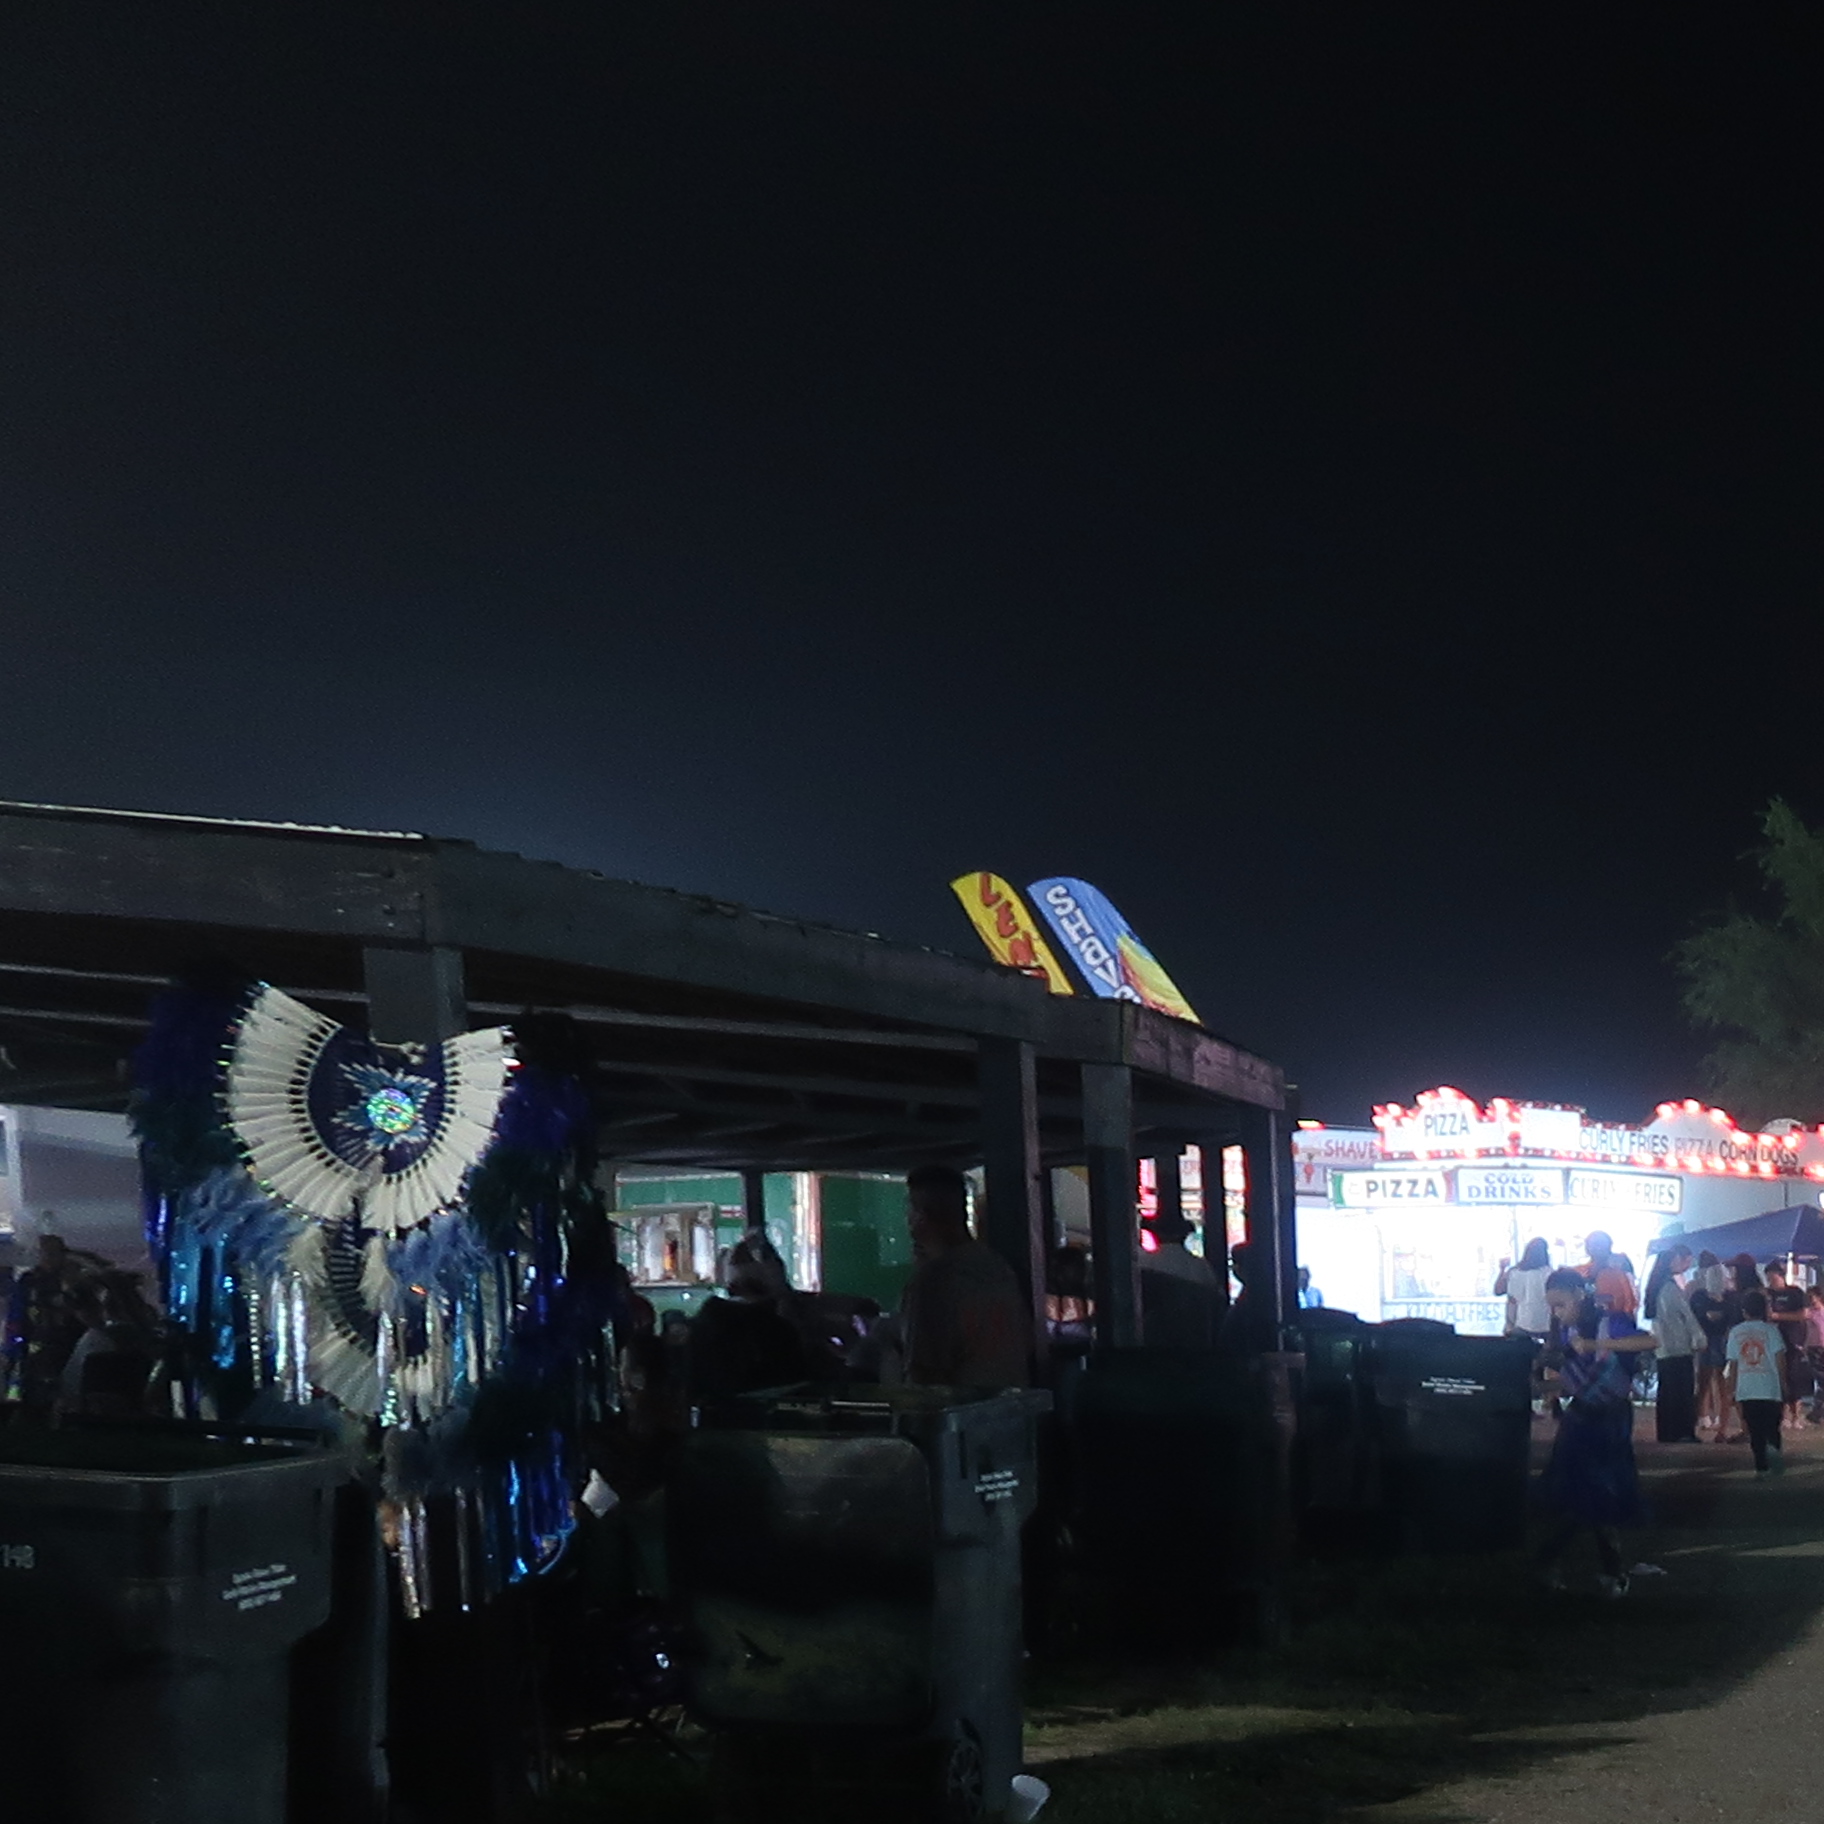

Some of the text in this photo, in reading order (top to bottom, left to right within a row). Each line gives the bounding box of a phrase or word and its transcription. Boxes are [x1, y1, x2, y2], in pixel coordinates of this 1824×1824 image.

[1424, 1112, 1471, 1137] PIZZA
[1324, 1138, 1375, 1161] SHAVE
[1578, 1127, 1627, 1151] CURLY
[1629, 1130, 1670, 1156] FRIES
[1365, 1178, 1440, 1200] PIZZA
[1484, 1172, 1535, 1185] COLD
[1467, 1184, 1553, 1200] DRINKS
[1635, 1182, 1677, 1207] FRIES
